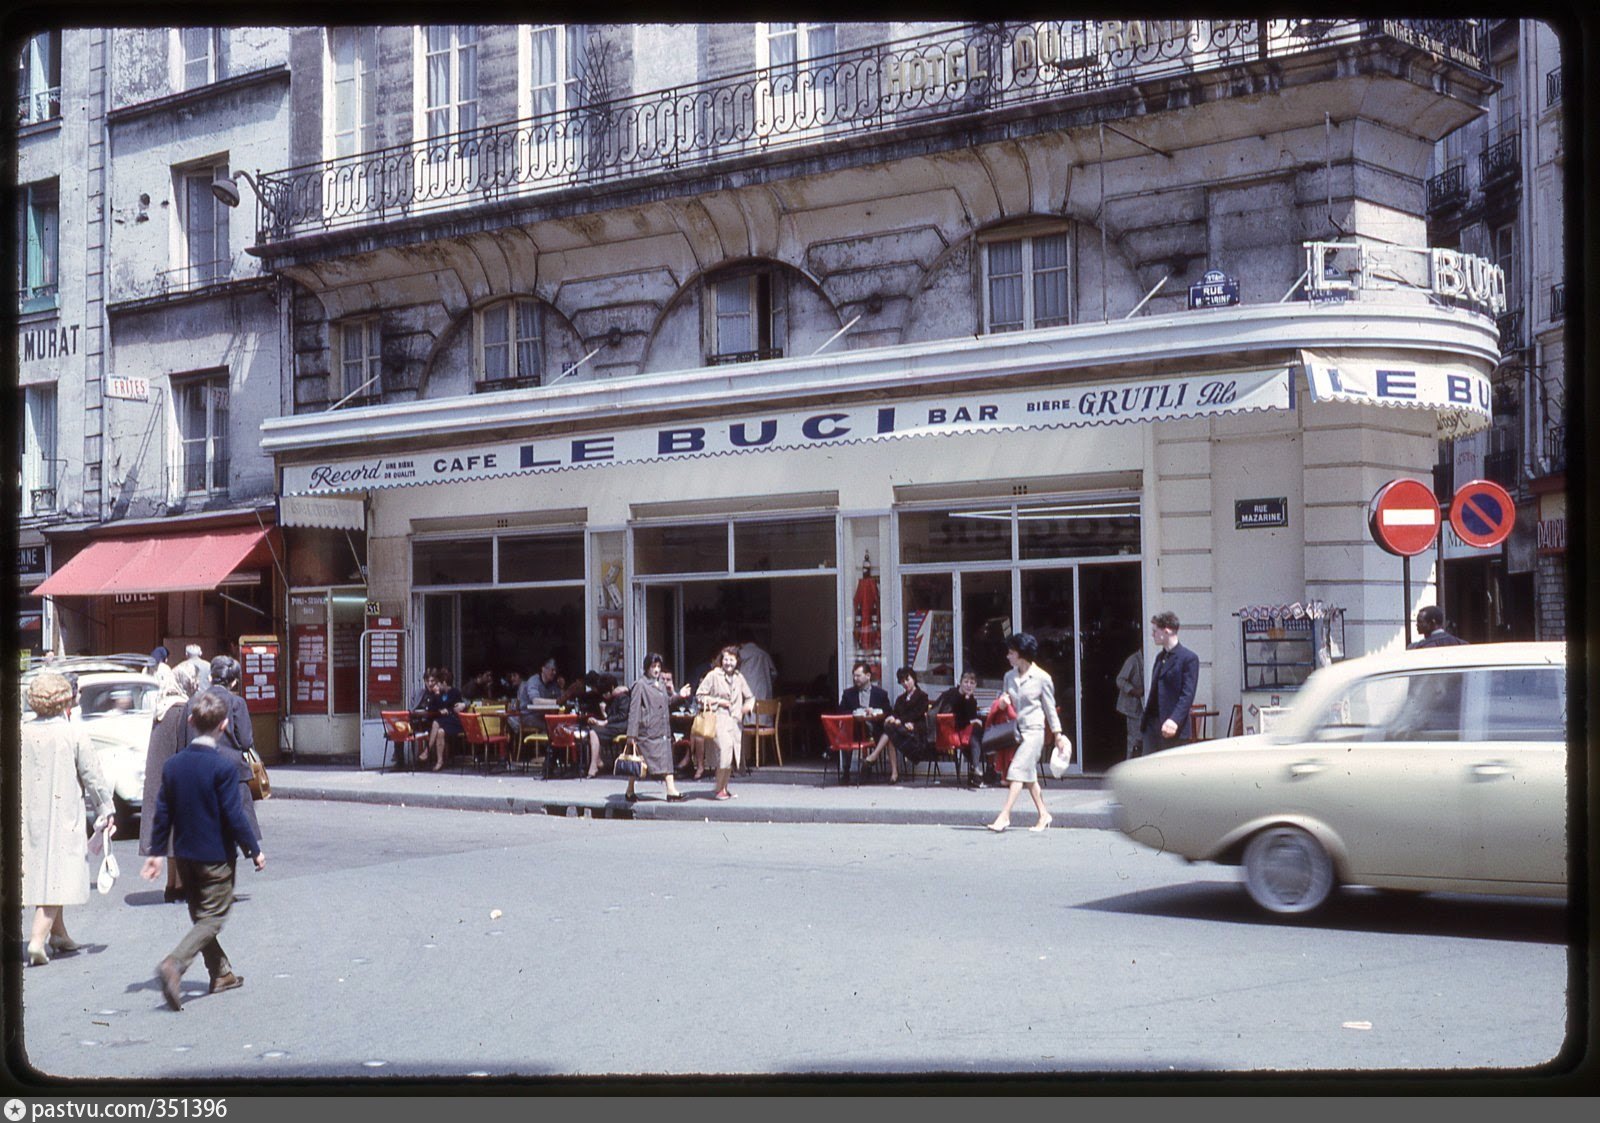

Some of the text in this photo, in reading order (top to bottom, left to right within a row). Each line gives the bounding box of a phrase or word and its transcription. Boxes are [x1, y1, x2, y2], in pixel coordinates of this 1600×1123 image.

[1015, 27, 1058, 68] DU
[1203, 286, 1224, 296] RUE
[24, 324, 80, 362] MURAT
[113, 379, 146, 395] FRITES
[1326, 368, 1418, 399] LE
[520, 437, 615, 469] LE
[658, 408, 896, 456] BUCI
[928, 405, 999, 425] BAR
[1078, 382, 1190, 417] GRUTLI
[1196, 381, 1238, 406] Pils
[309, 460, 383, 489] Record
[1241, 512, 1282, 523] MAZARINE
[1254, 504, 1268, 513] RUE
